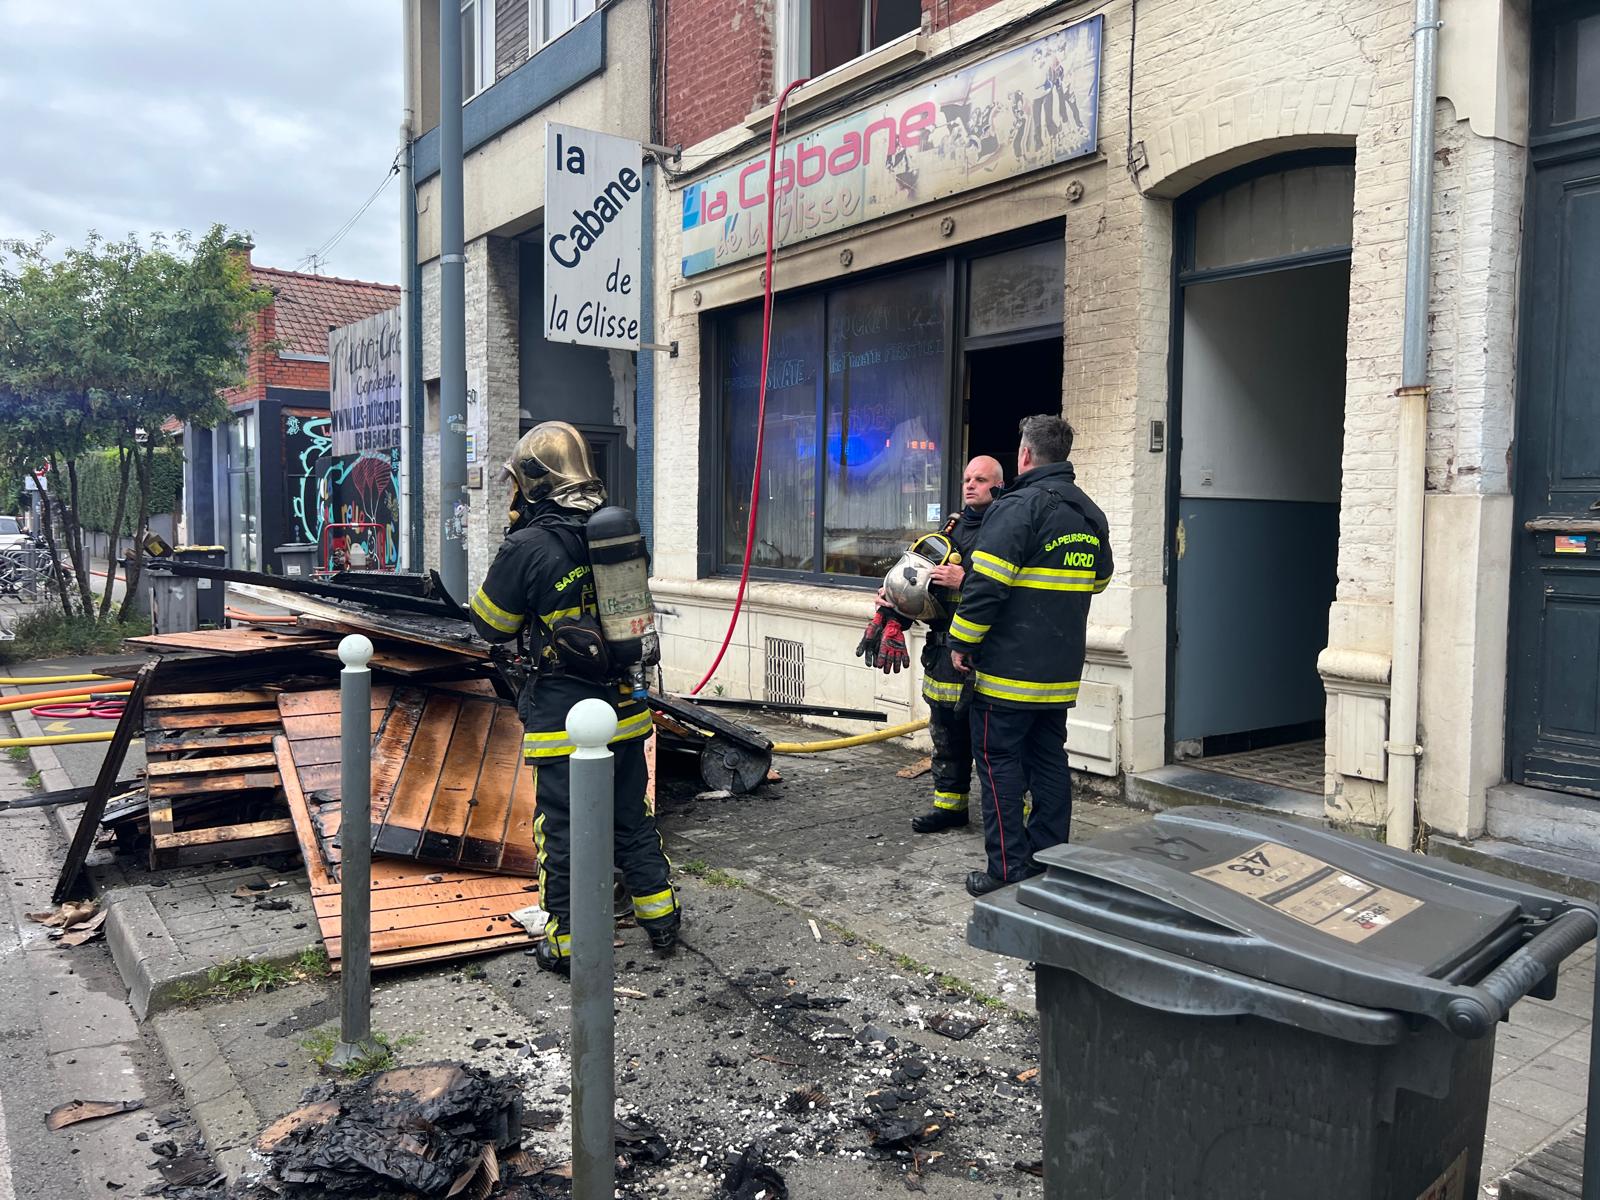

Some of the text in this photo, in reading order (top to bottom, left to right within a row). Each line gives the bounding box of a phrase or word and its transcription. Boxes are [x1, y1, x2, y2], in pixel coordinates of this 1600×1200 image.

[556, 134, 586, 175] la
[701, 102, 937, 225] la Cabane
[549, 167, 641, 269] Cabane
[717, 187, 862, 259] de la Glisse
[606, 257, 632, 295] de
[549, 294, 639, 340] la Glisse
[1063, 551, 1095, 568] NORD
